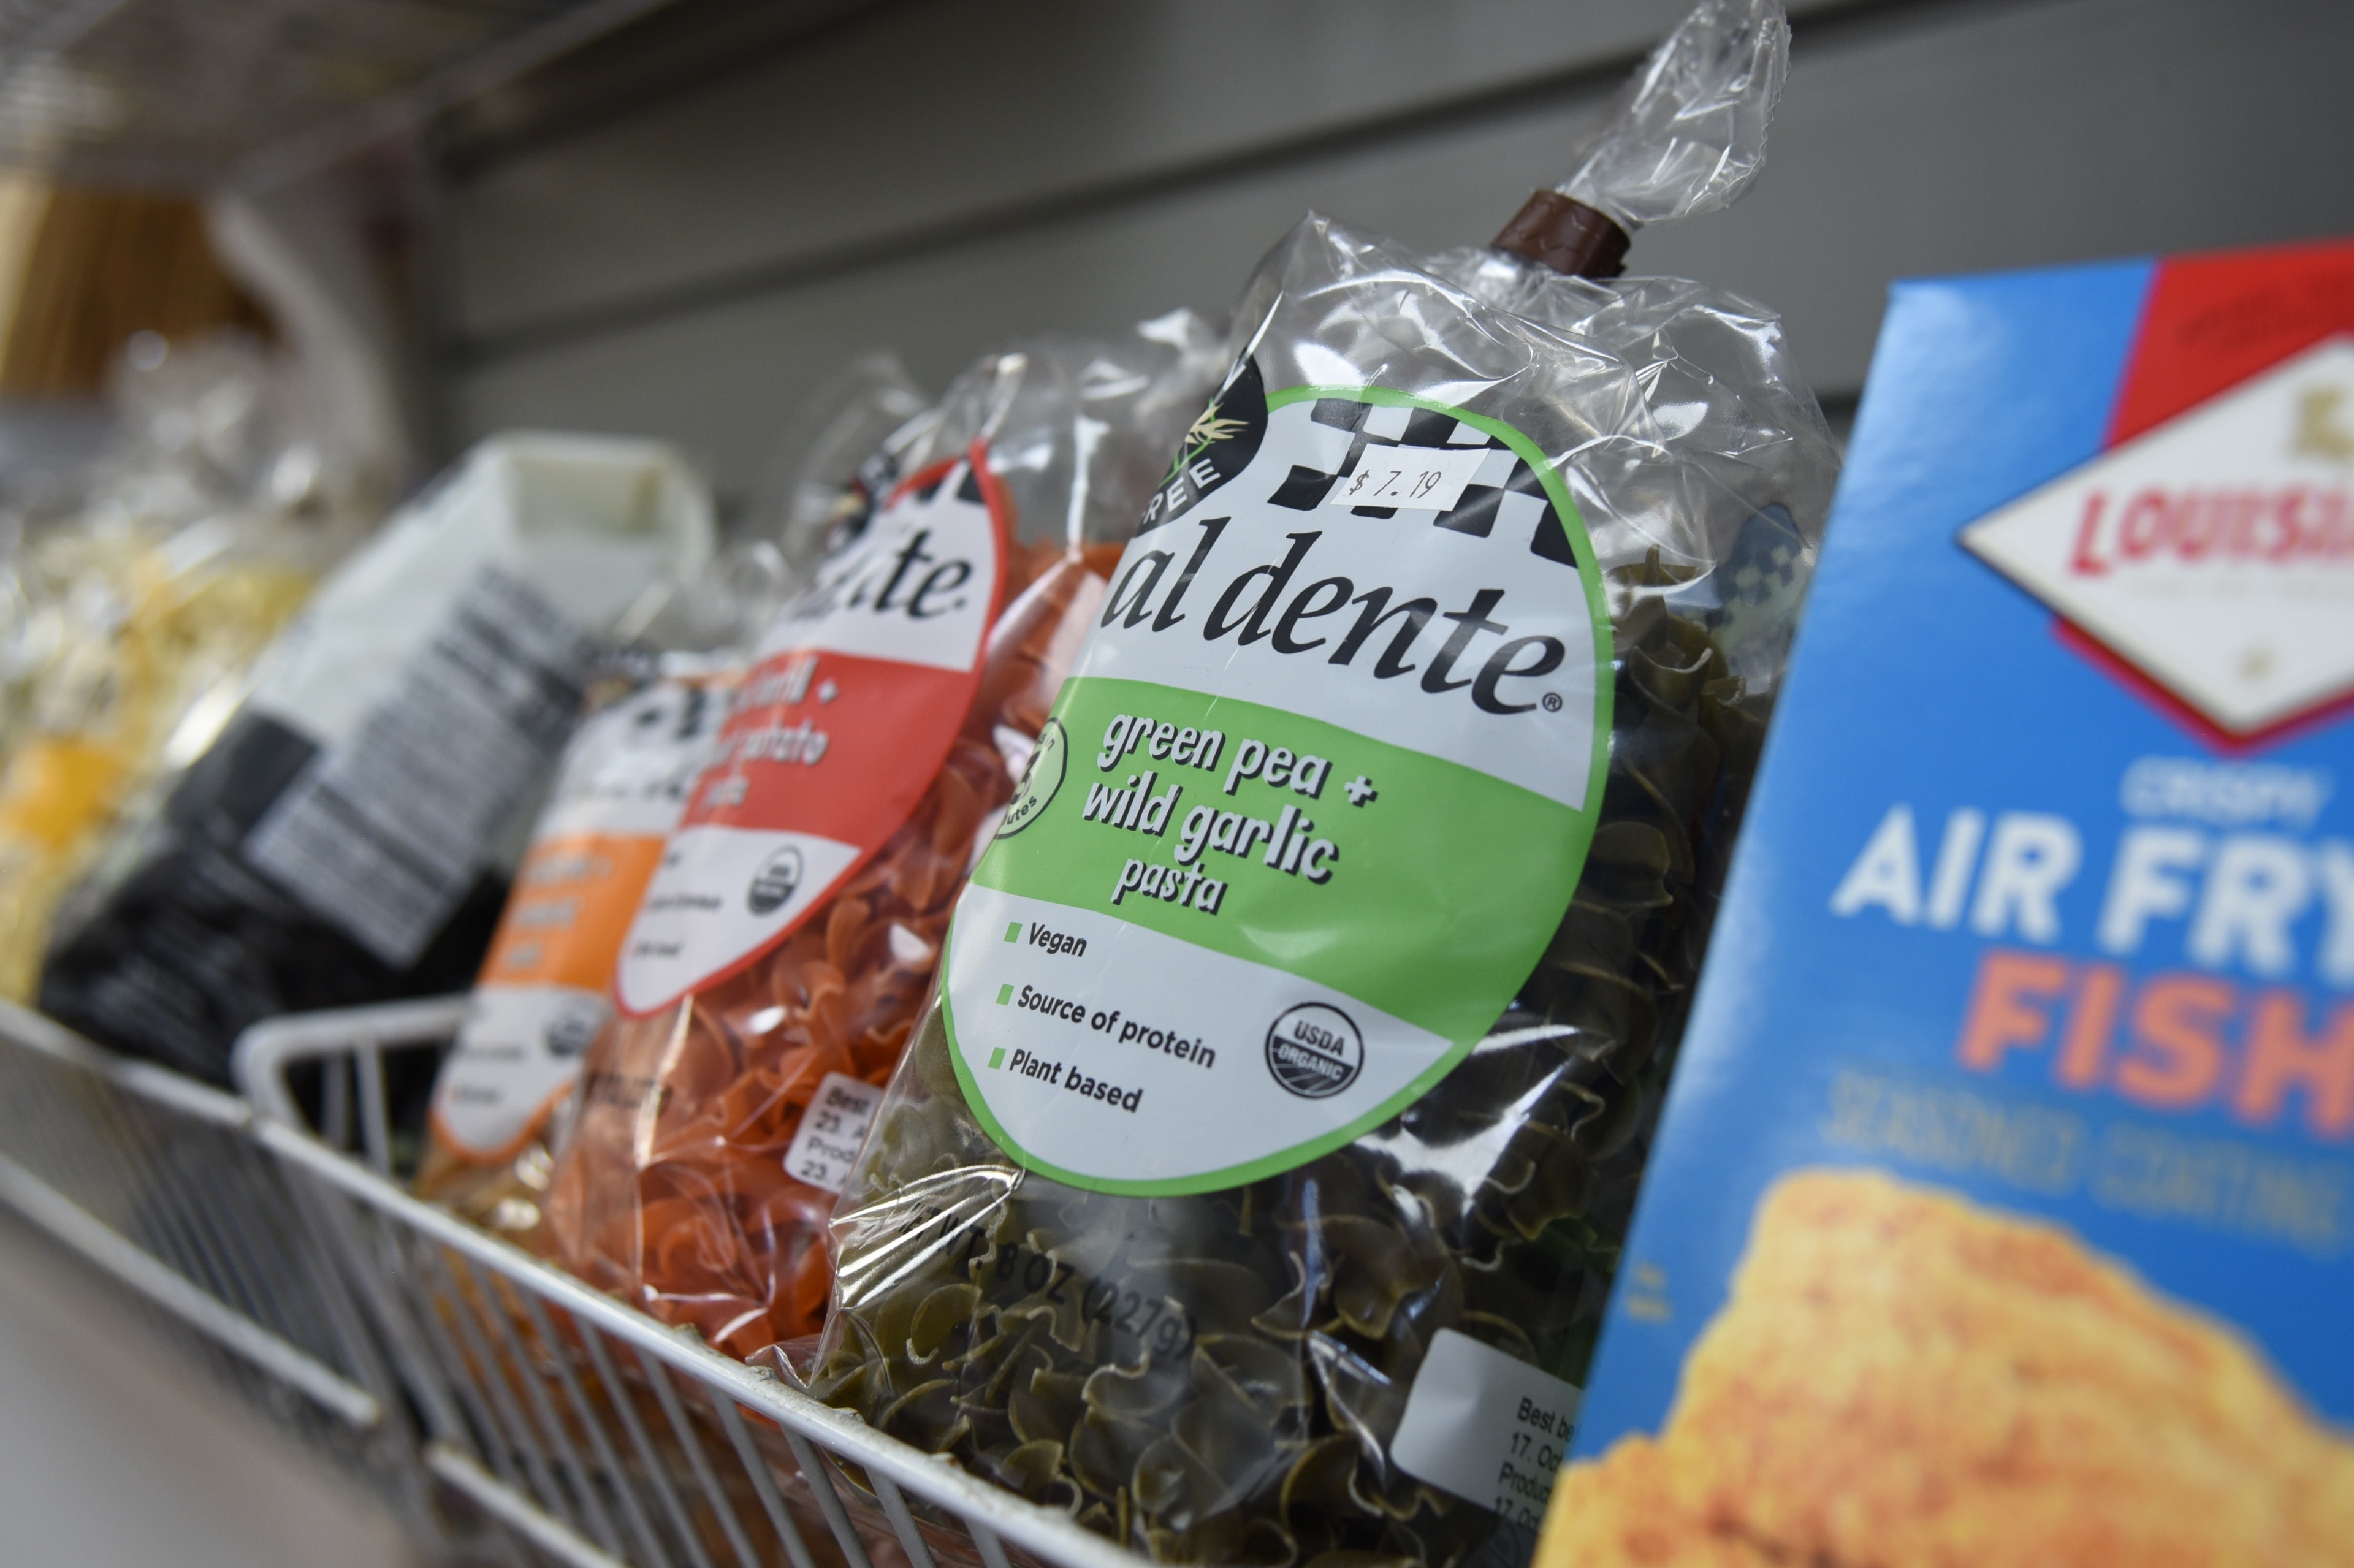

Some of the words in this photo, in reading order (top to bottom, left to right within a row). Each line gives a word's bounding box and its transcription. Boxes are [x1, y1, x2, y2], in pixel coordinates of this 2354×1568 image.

[1141, 457, 1221, 525] REE
[1373, 470, 1442, 499] 7.19
[1100, 516, 1231, 633] al
[1202, 530, 1566, 716] dente
[1097, 713, 1225, 772] green
[1222, 737, 1333, 799] pea
[1082, 769, 1183, 837] wild
[1174, 804, 1340, 885] garlic
[1110, 858, 1228, 916] pasta
[1828, 801, 2083, 944] AIR
[1028, 921, 1088, 957] Vegan
[1017, 984, 1086, 1024] Source
[1091, 1010, 1119, 1035] of
[1119, 1019, 1217, 1069] protein
[1294, 1020, 1344, 1057] USDA
[1956, 948, 2354, 1145] FISH
[1009, 1048, 1062, 1085] Plant
[1064, 1065, 1144, 1113] based
[1277, 1043, 1344, 1081] ORGANIC
[1517, 1396, 1556, 1433] Best
